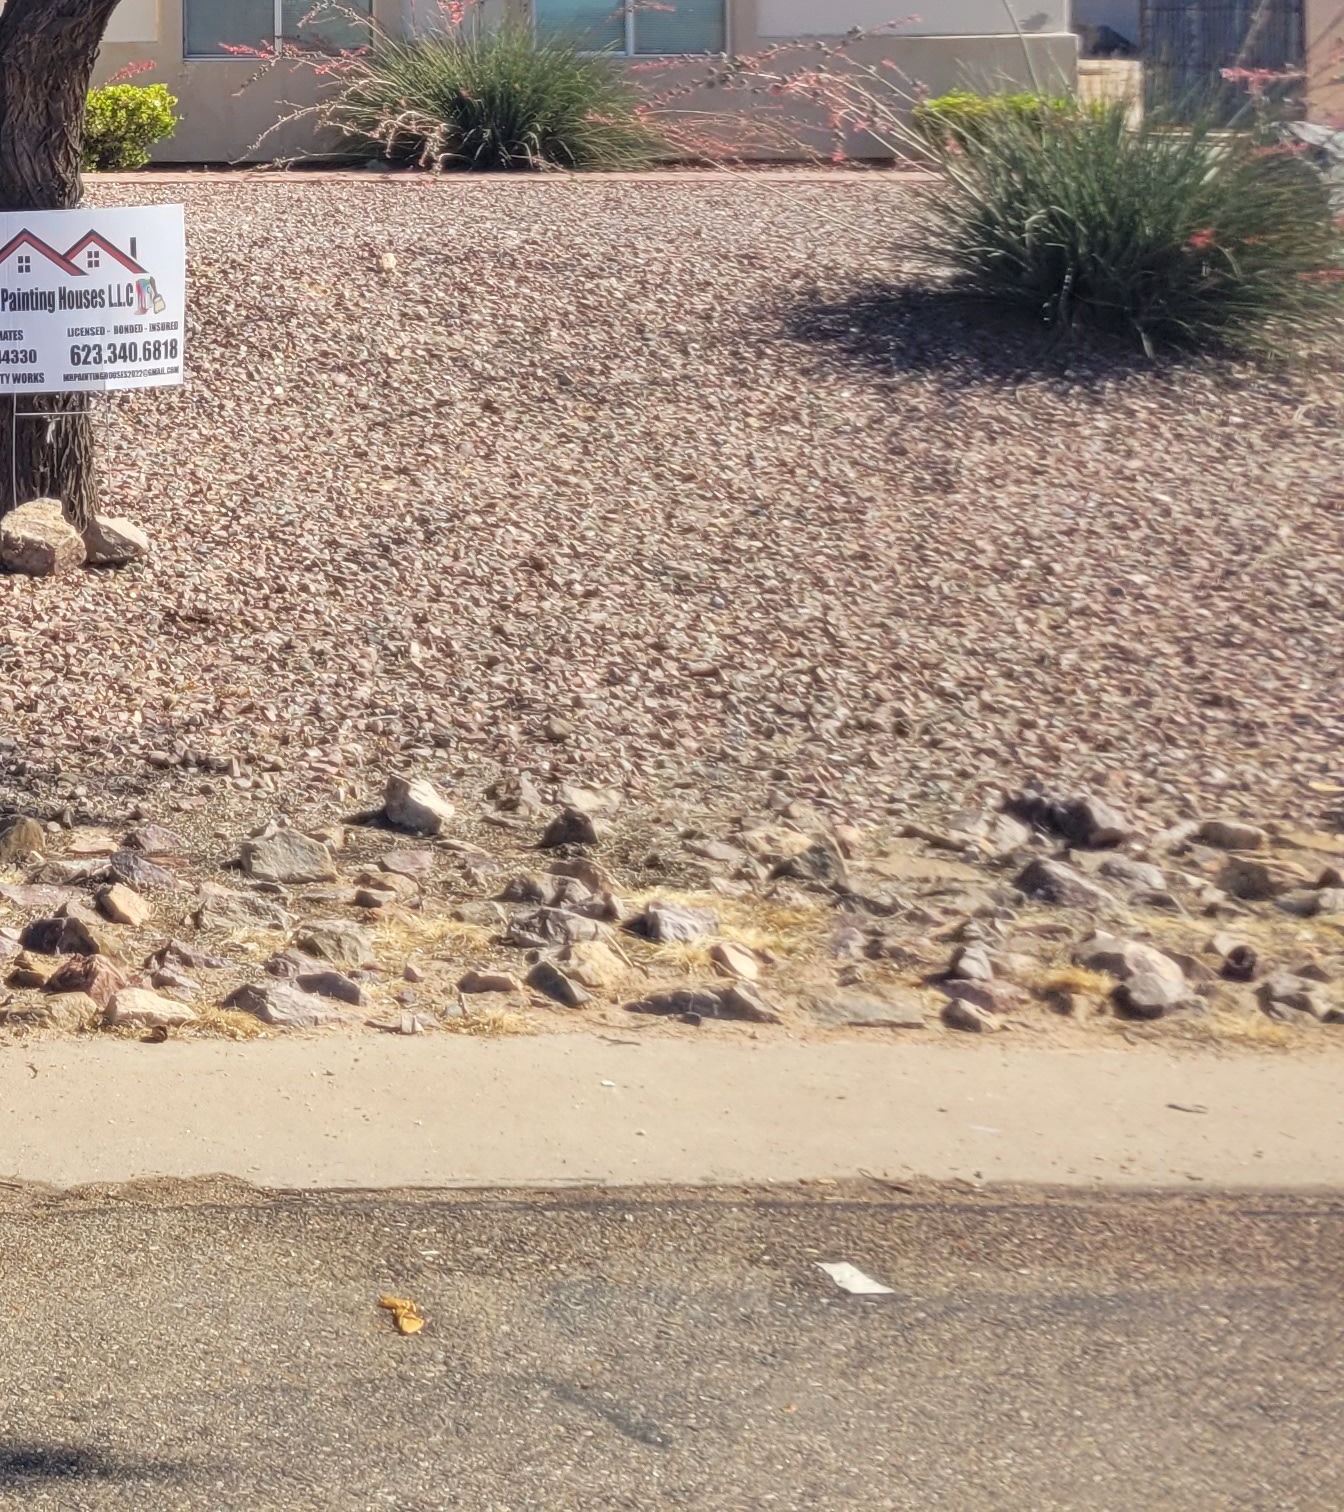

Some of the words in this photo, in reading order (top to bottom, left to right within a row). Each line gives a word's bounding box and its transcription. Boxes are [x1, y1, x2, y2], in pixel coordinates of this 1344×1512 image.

[1, 288, 55, 313] Painting
[58, 286, 105, 311] Houses
[67, 327, 105, 337] LICENSED
[114, 324, 143, 334] BONDED
[149, 321, 178, 332] INSURED
[70, 339, 178, 366] 623.340.6818
[10, 373, 45, 384] WORKS
